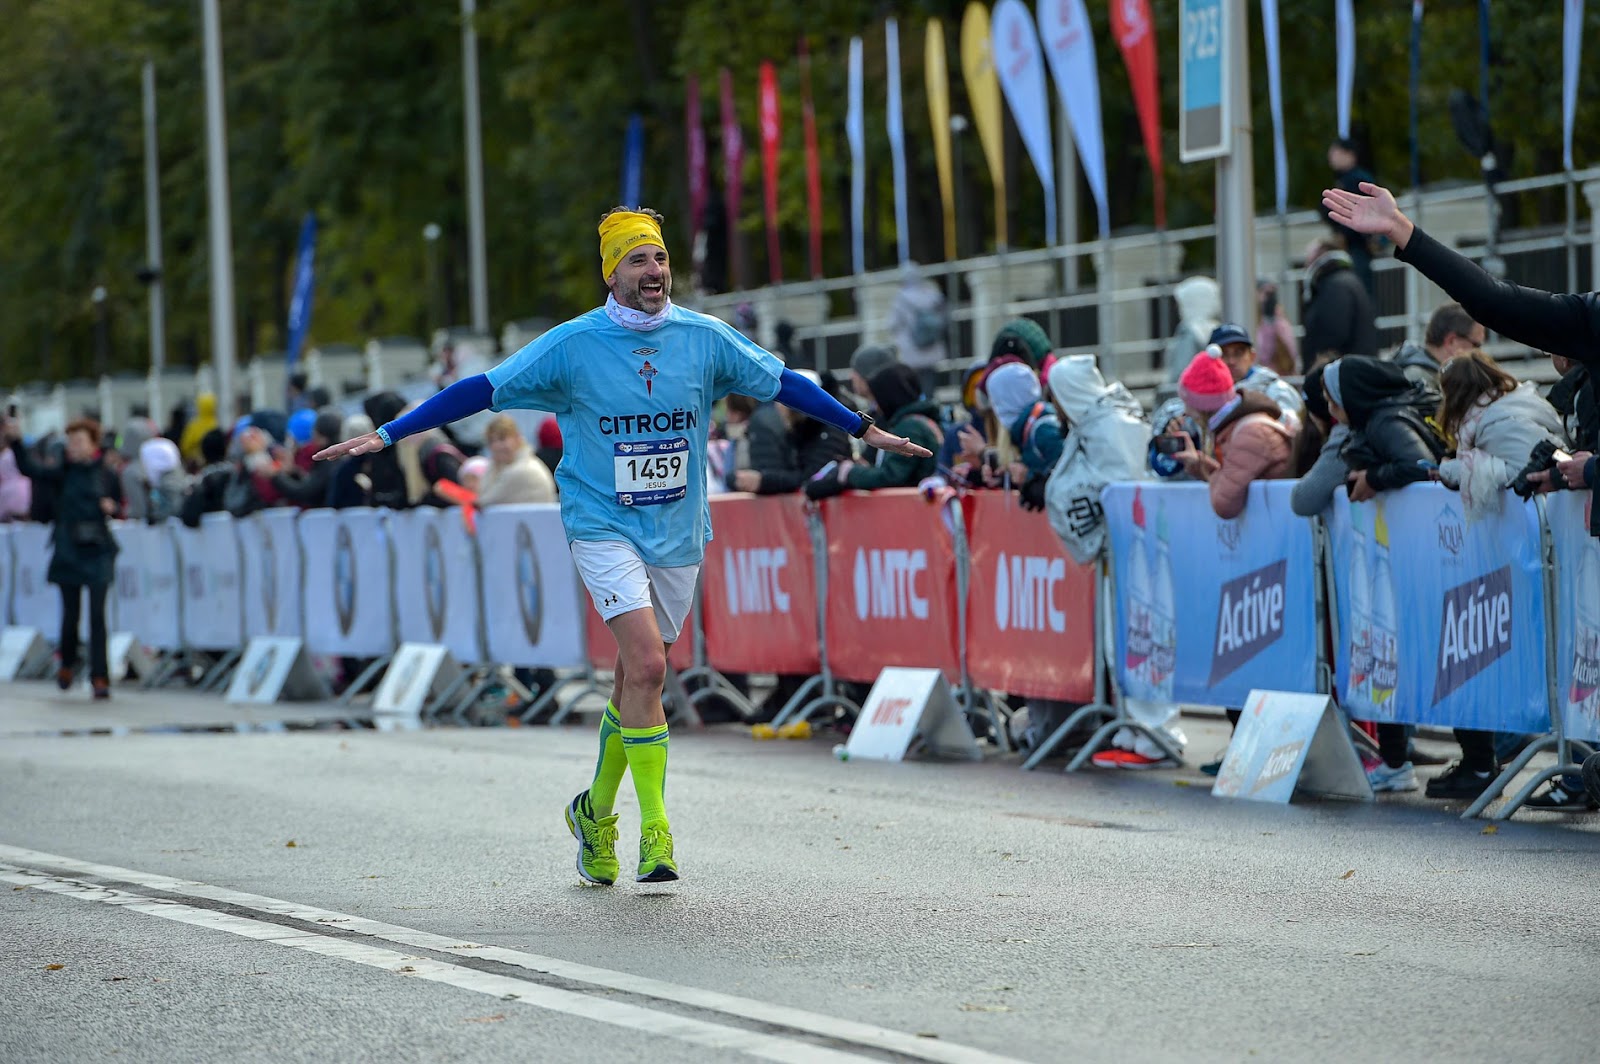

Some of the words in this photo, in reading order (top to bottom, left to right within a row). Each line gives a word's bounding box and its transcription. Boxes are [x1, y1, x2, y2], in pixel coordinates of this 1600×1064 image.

[599, 408, 697, 435] CITROËN
[627, 456, 681, 481] 1459
[645, 481, 667, 489] JESUS
[1438, 521, 1464, 555] AQUA
[1217, 575, 1284, 656] Active
[1442, 583, 1511, 670] Active
